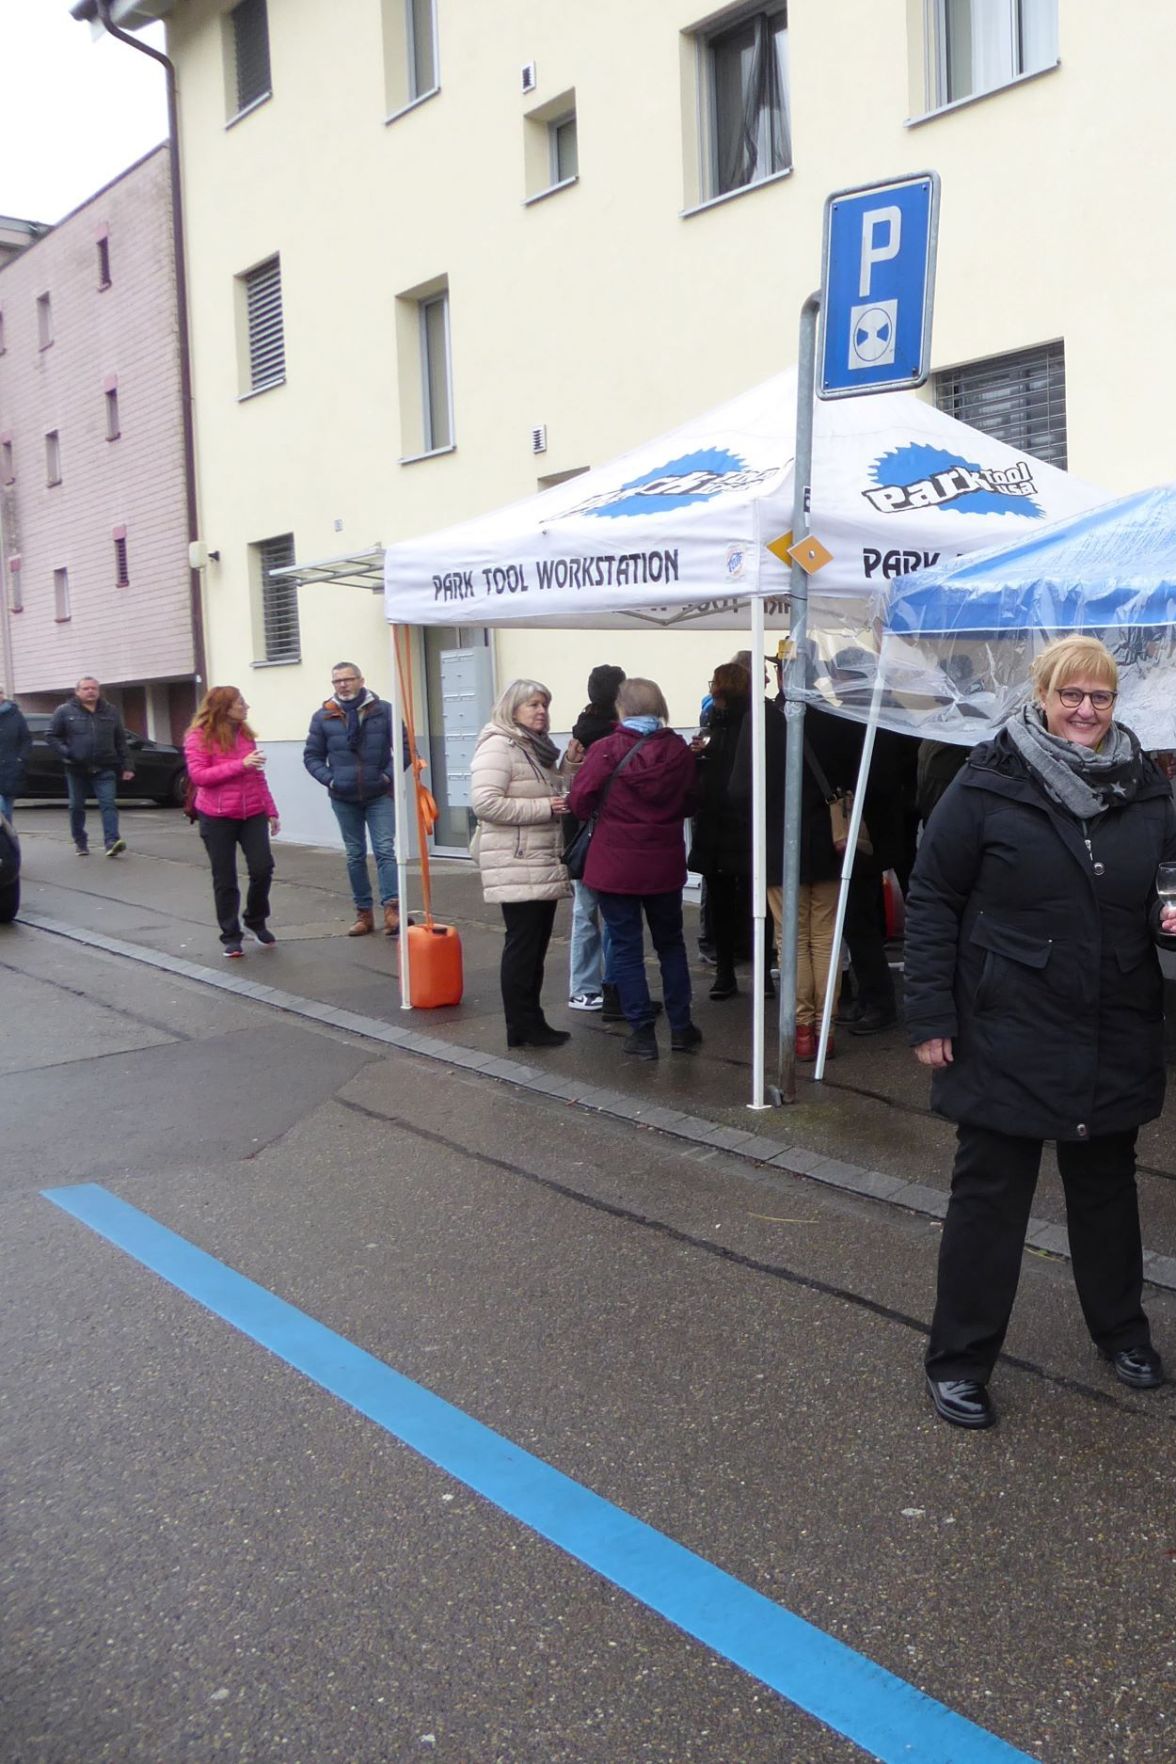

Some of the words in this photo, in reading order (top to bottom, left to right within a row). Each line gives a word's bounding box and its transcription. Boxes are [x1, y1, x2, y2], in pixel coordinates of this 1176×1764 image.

[859, 205, 902, 297] P
[862, 466, 988, 513] Park
[432, 572, 475, 601] PARK
[482, 564, 529, 596] TOOL
[536, 549, 679, 590] WORKSTATION
